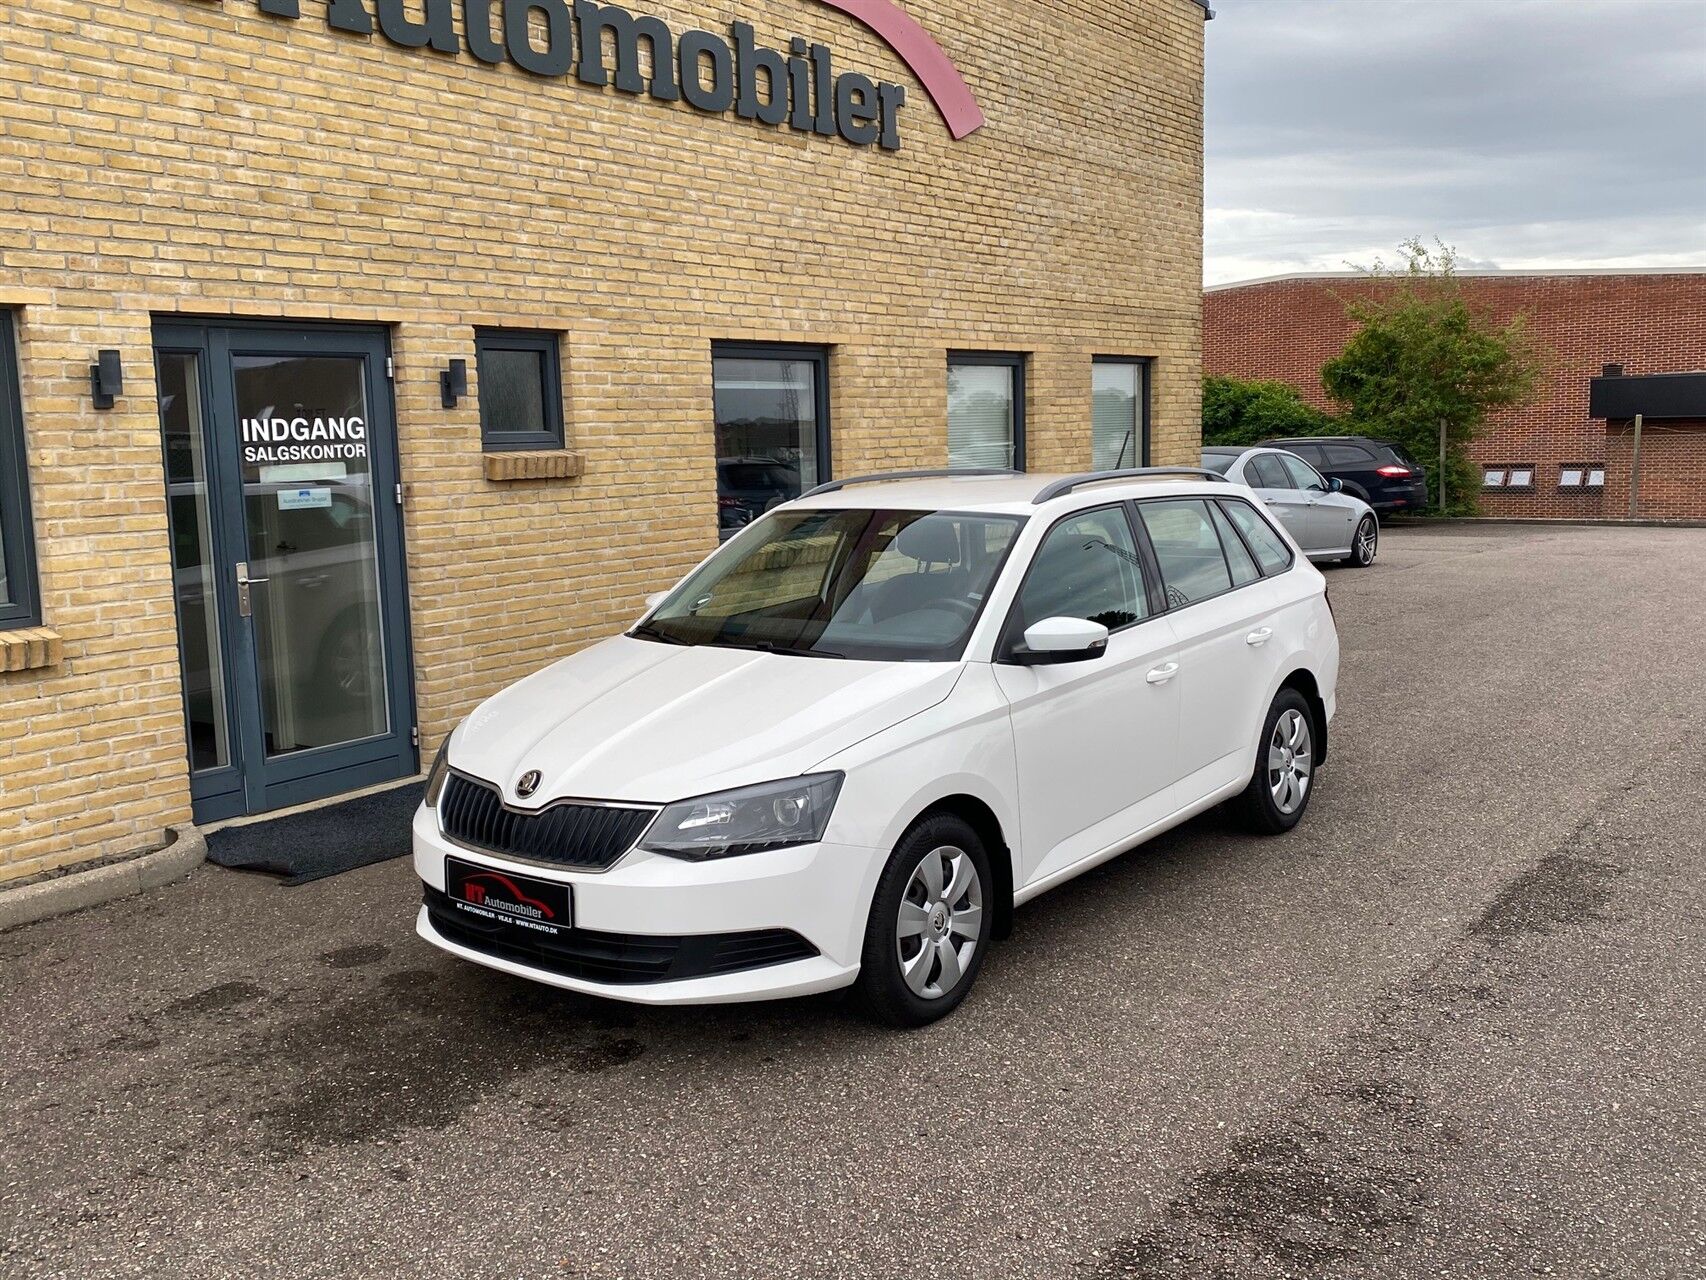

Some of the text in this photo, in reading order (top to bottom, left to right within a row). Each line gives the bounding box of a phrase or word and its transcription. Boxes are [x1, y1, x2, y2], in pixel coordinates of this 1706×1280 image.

[259, 0, 905, 150] utomobiler
[242, 417, 365, 442] INDGANG
[244, 444, 367, 462] SALGSKONTOR
[484, 895, 543, 919] Automobiler
[464, 905, 496, 919] AUTOMOBILER
[498, 914, 513, 924] VEJLE
[515, 919, 558, 935] WWW.NTAUTO.DK
